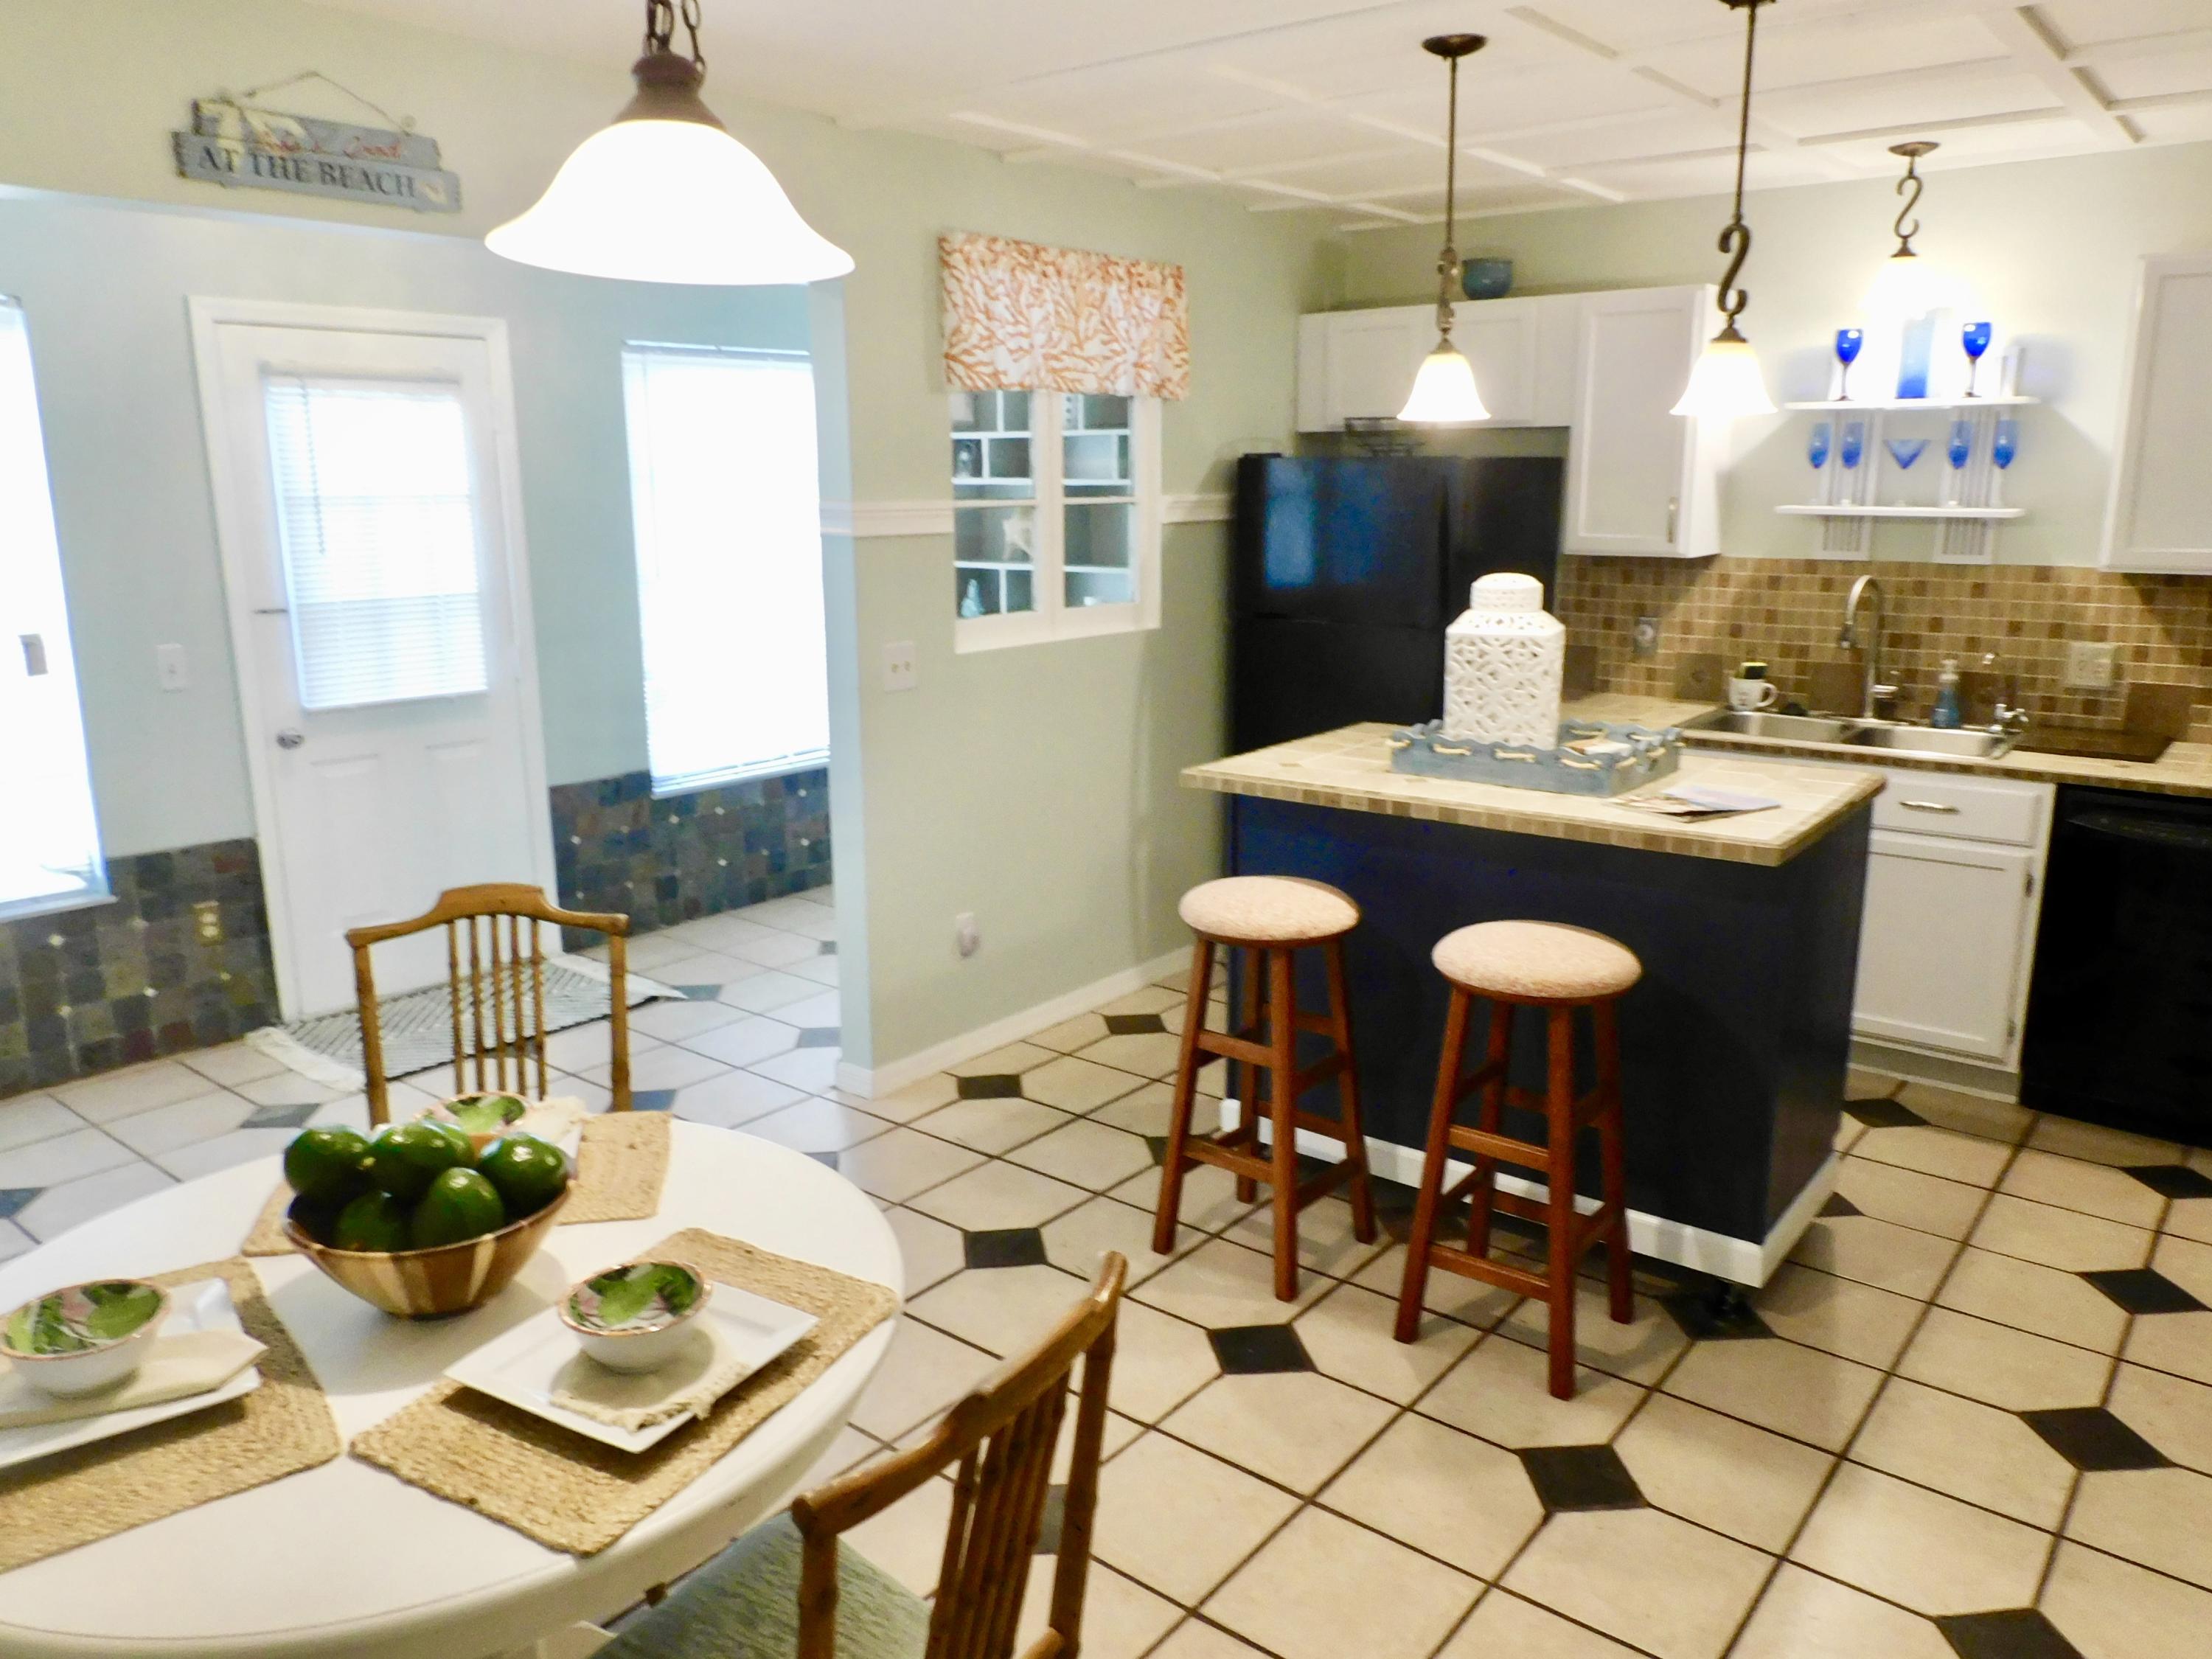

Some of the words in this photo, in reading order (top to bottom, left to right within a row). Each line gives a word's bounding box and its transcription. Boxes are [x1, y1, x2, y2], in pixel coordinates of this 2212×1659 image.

[198, 146, 239, 173] AT
[248, 150, 310, 183] THE
[318, 161, 416, 198] BEACH
